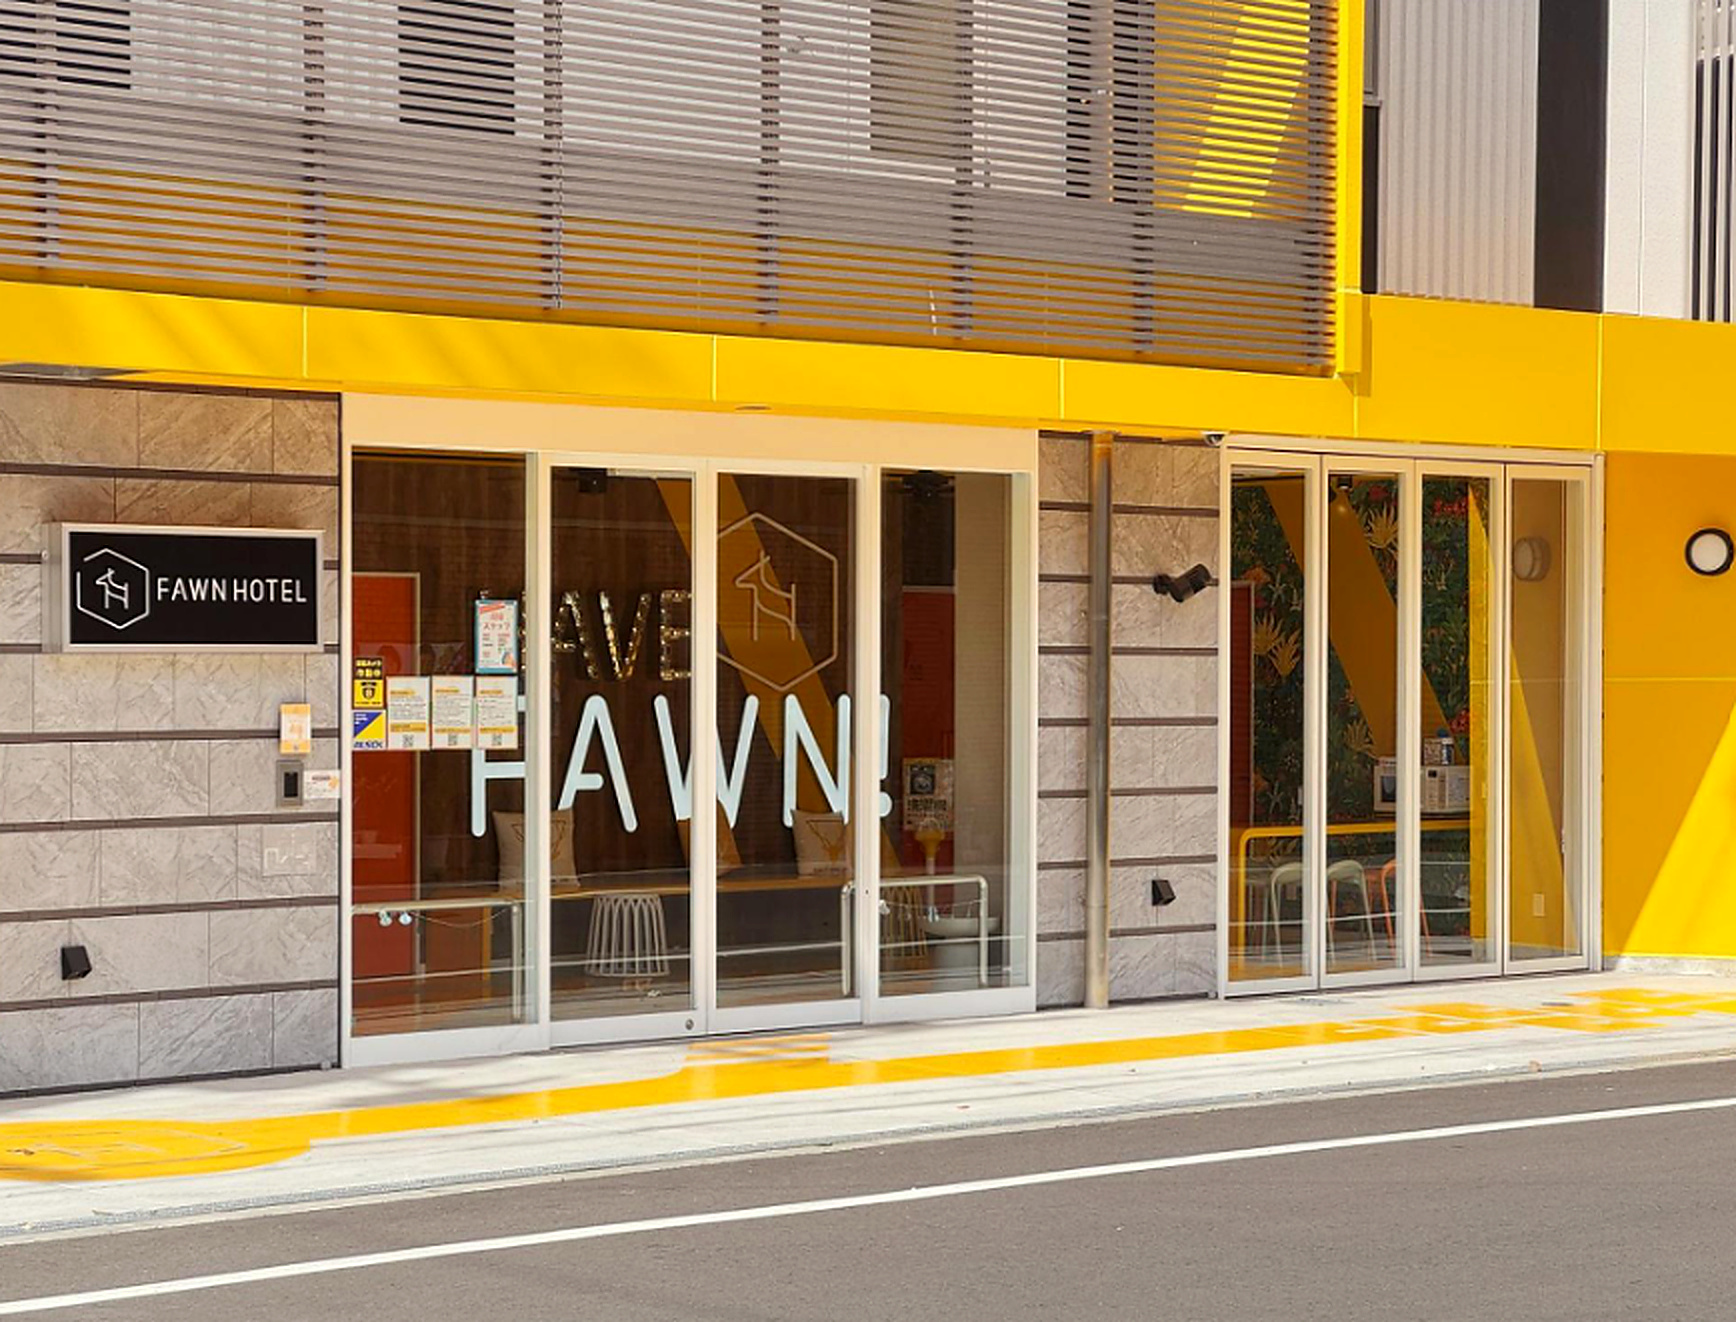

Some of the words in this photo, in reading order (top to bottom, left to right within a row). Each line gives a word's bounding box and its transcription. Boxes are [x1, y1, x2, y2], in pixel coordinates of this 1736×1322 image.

[156, 577, 227, 602] FAWN
[233, 578, 308, 603] HOTEL
[479, 590, 692, 681] AVE
